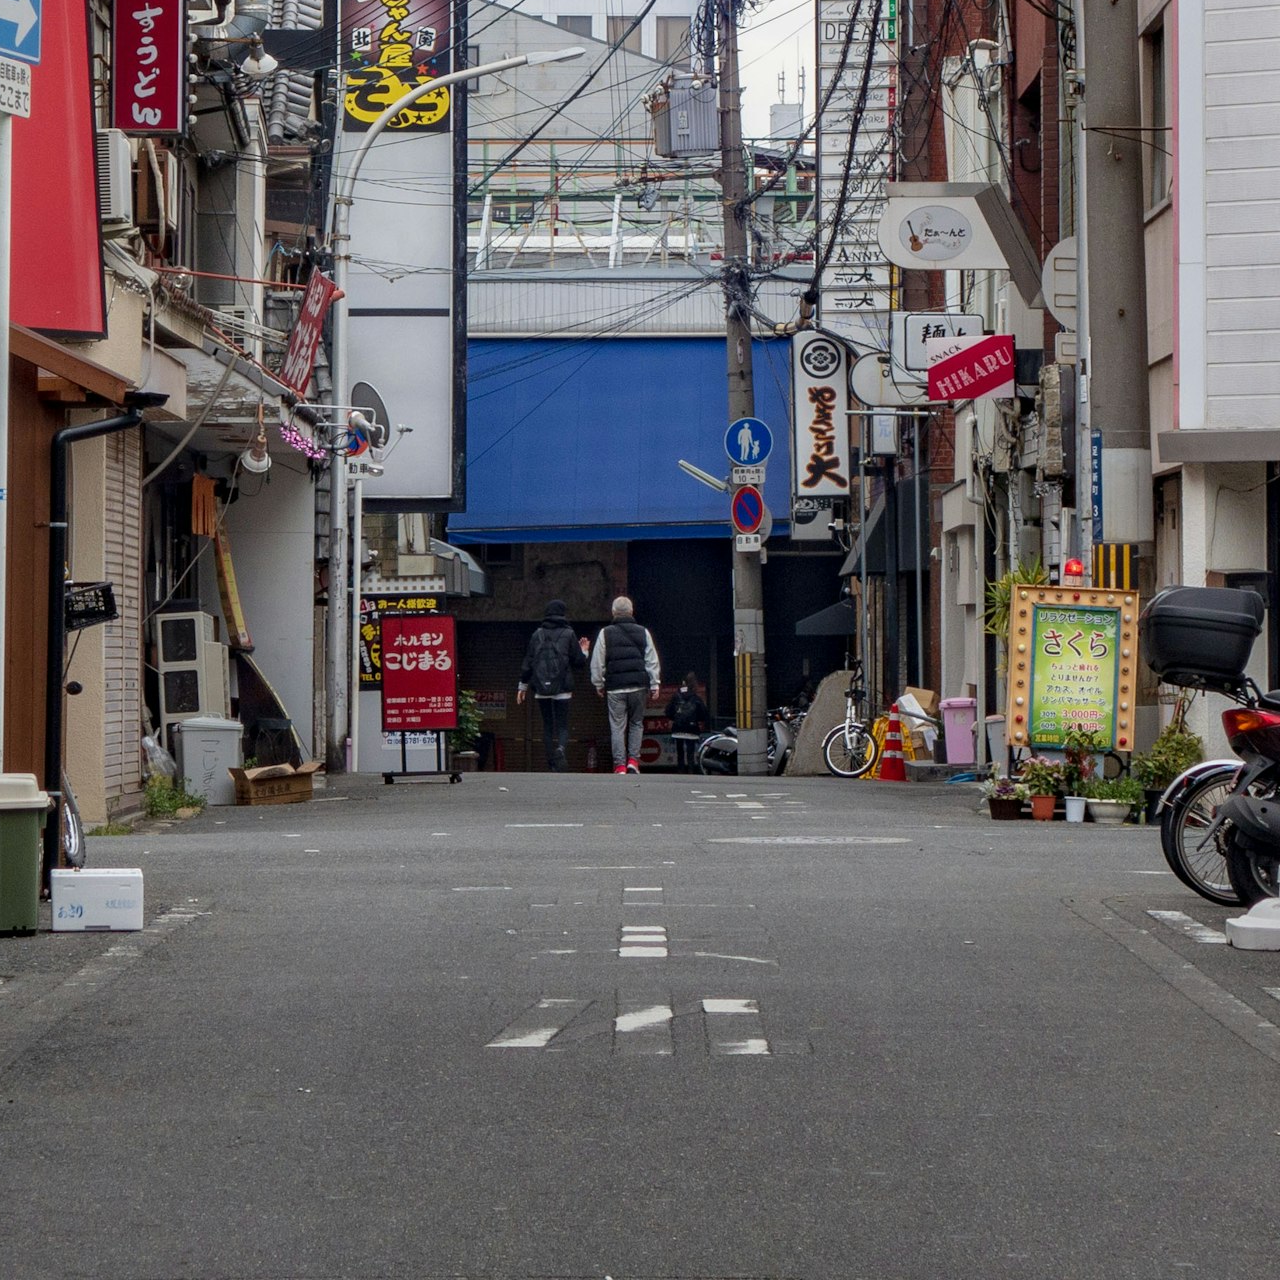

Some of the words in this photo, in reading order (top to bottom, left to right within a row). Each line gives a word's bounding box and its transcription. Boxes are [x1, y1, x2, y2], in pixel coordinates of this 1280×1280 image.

[0, 83, 30, 113] ここまで
[836, 246, 882, 262] ANNY
[930, 343, 963, 363] SNACK
[935, 345, 1013, 398] HIKARU
[1039, 611, 1114, 626] リラクゼーション
[393, 632, 444, 647] ホルモン
[1042, 629, 1108, 658] さくら
[384, 649, 452, 671] こじまる
